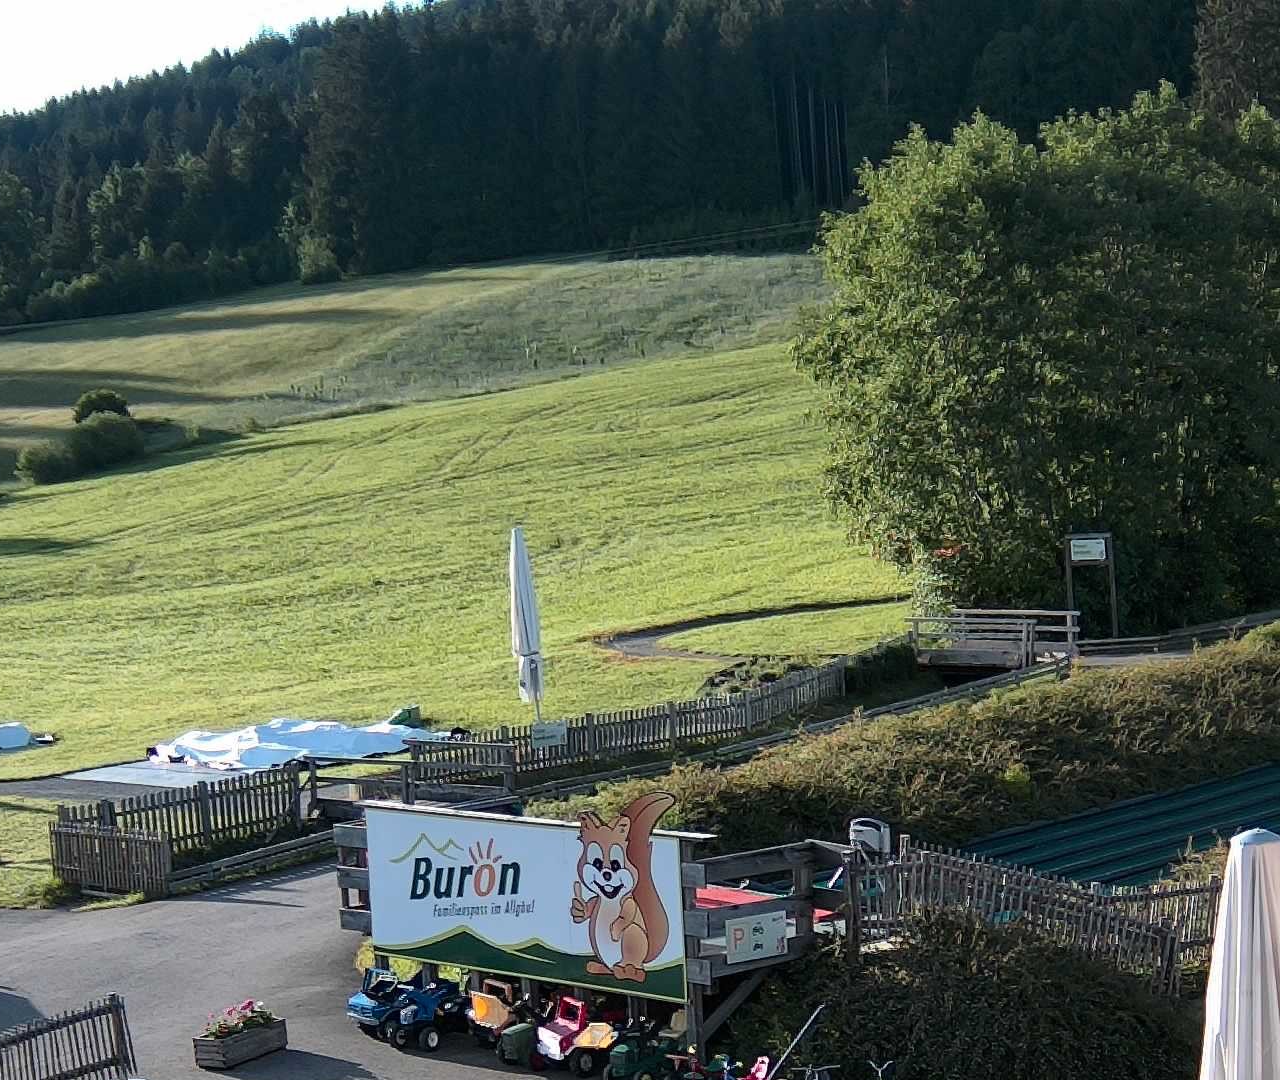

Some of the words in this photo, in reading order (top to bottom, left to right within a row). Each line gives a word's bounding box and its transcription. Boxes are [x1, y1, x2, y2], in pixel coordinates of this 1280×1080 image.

[410, 856, 521, 900] Buron
[433, 902, 488, 919] Familienspass
[491, 902, 501, 914] im
[733, 928, 745, 951] P
